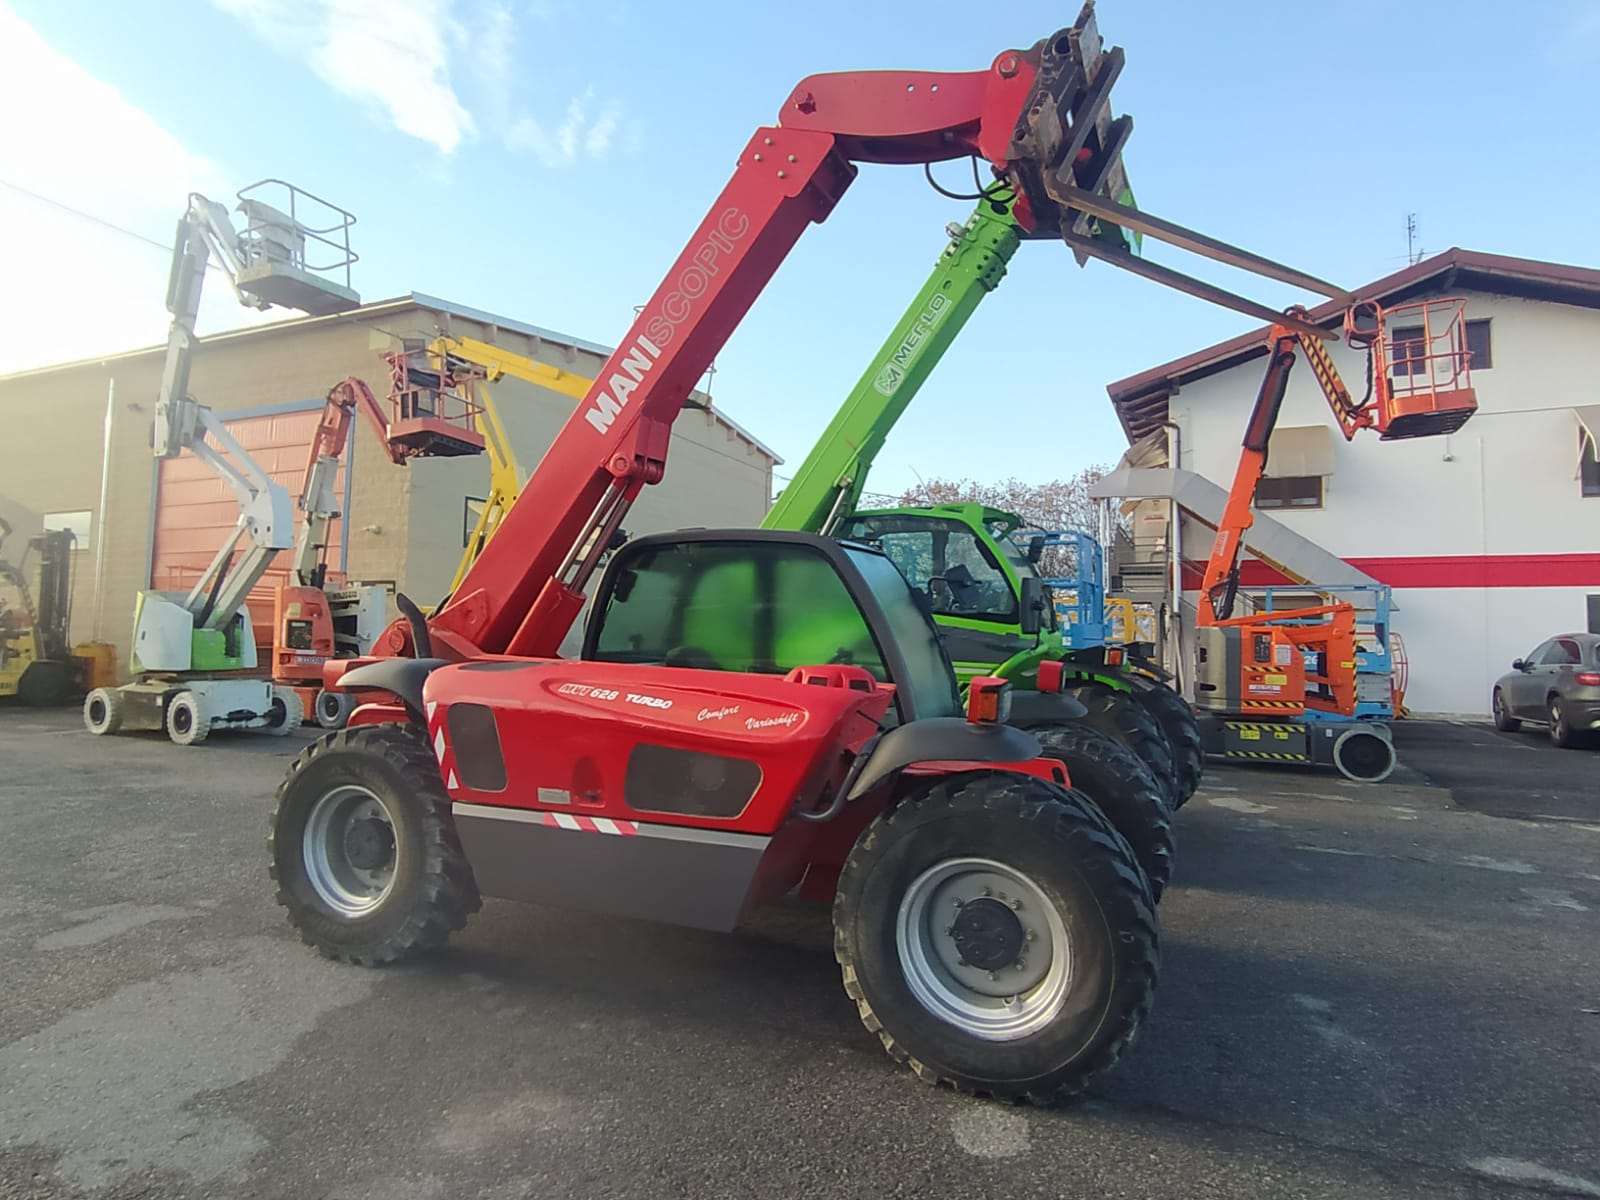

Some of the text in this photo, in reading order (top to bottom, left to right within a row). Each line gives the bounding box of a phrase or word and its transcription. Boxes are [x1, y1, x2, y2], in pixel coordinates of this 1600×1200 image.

[584, 206, 750, 436] MANISCOPIC
[590, 688, 619, 701] 628
[625, 692, 673, 710] TURBO
[697, 704, 740, 721] Comfort
